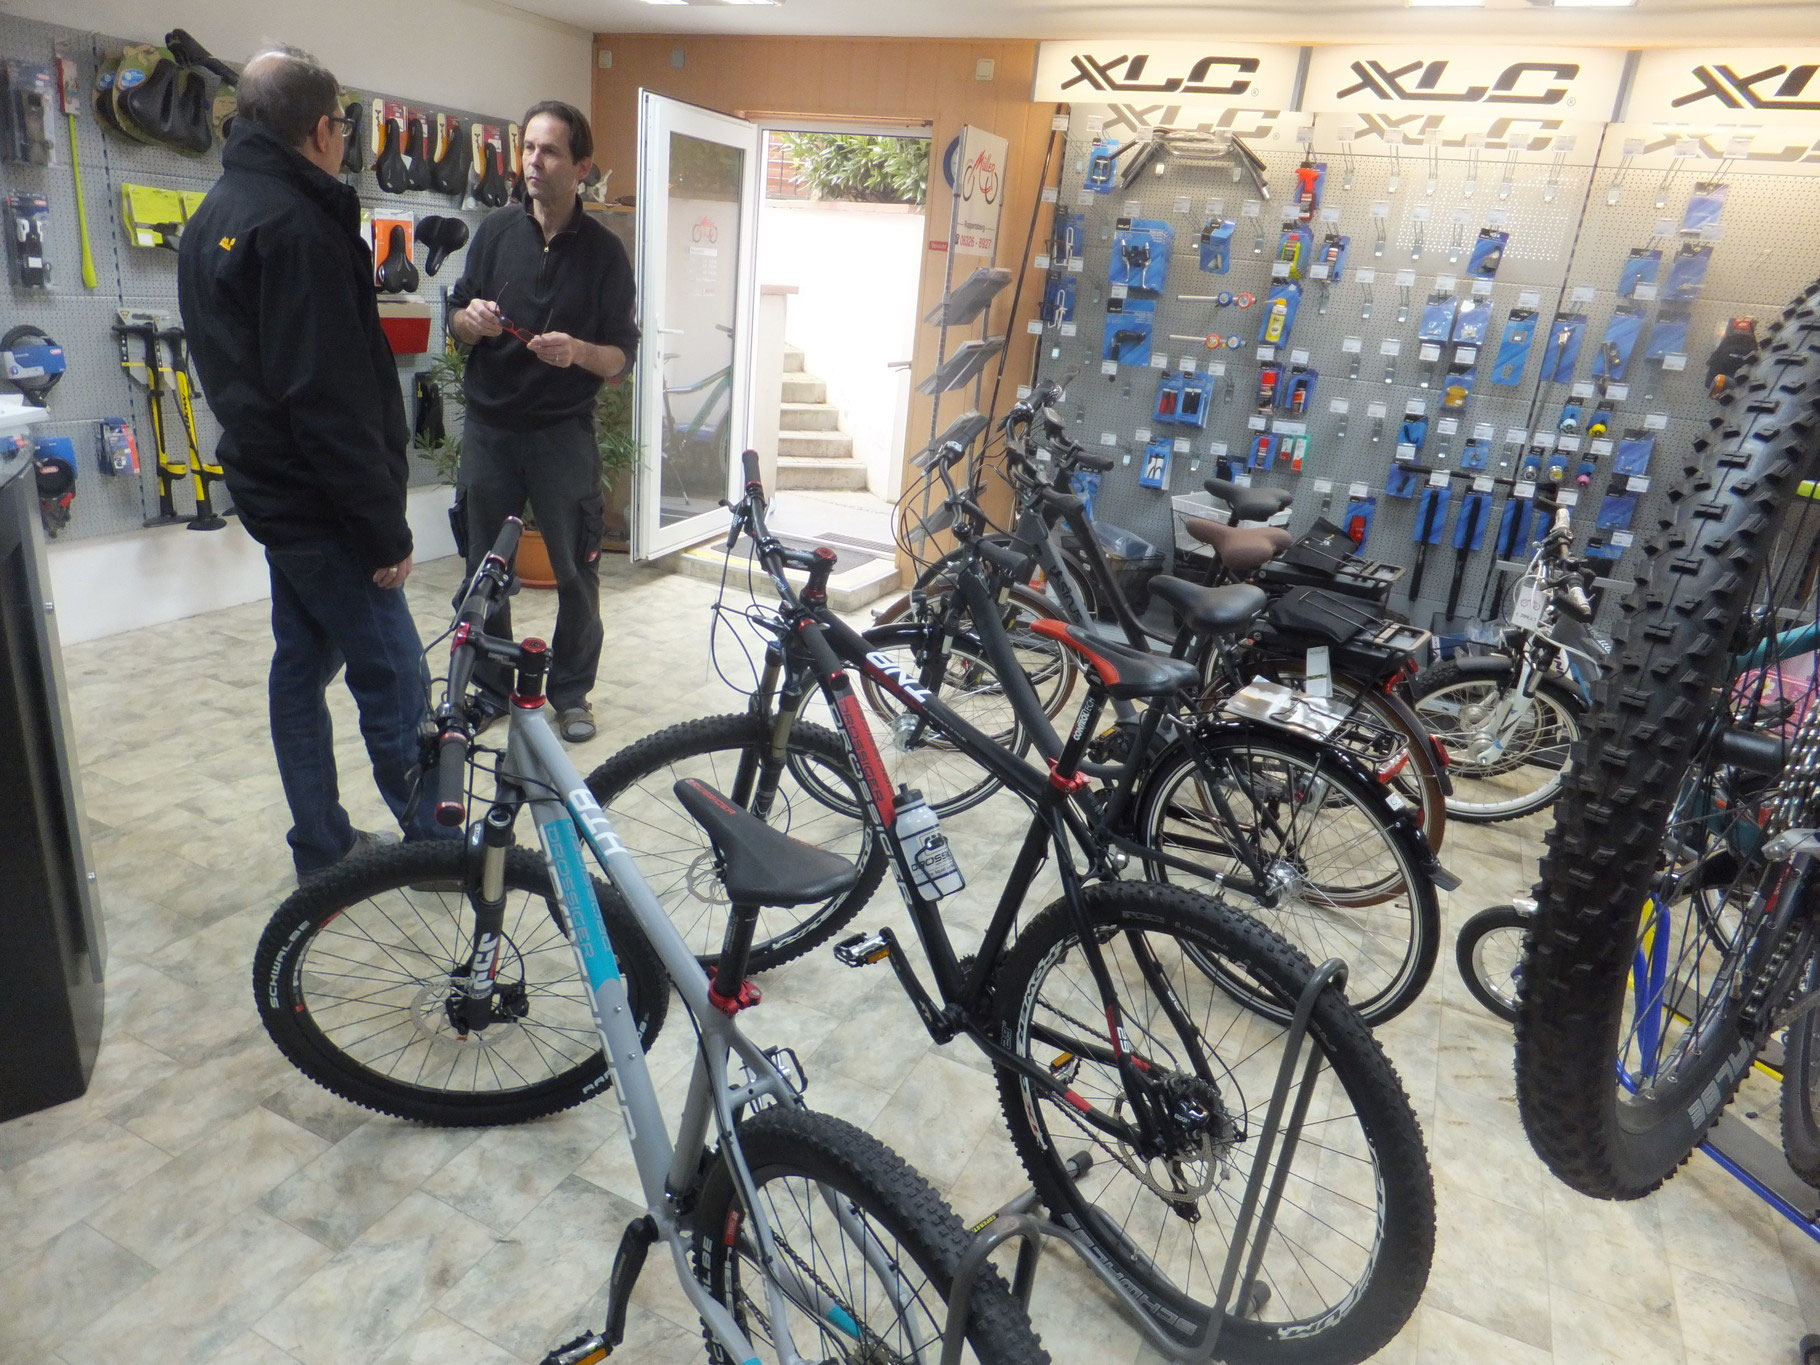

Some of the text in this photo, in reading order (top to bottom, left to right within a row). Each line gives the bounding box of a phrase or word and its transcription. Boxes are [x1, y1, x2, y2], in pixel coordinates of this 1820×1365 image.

[1061, 54, 1261, 95] XLC
[1336, 60, 1580, 105] XLC
[1073, 697, 1095, 742] CONTROLTECH
[268, 920, 311, 1009] SCHWALBE
